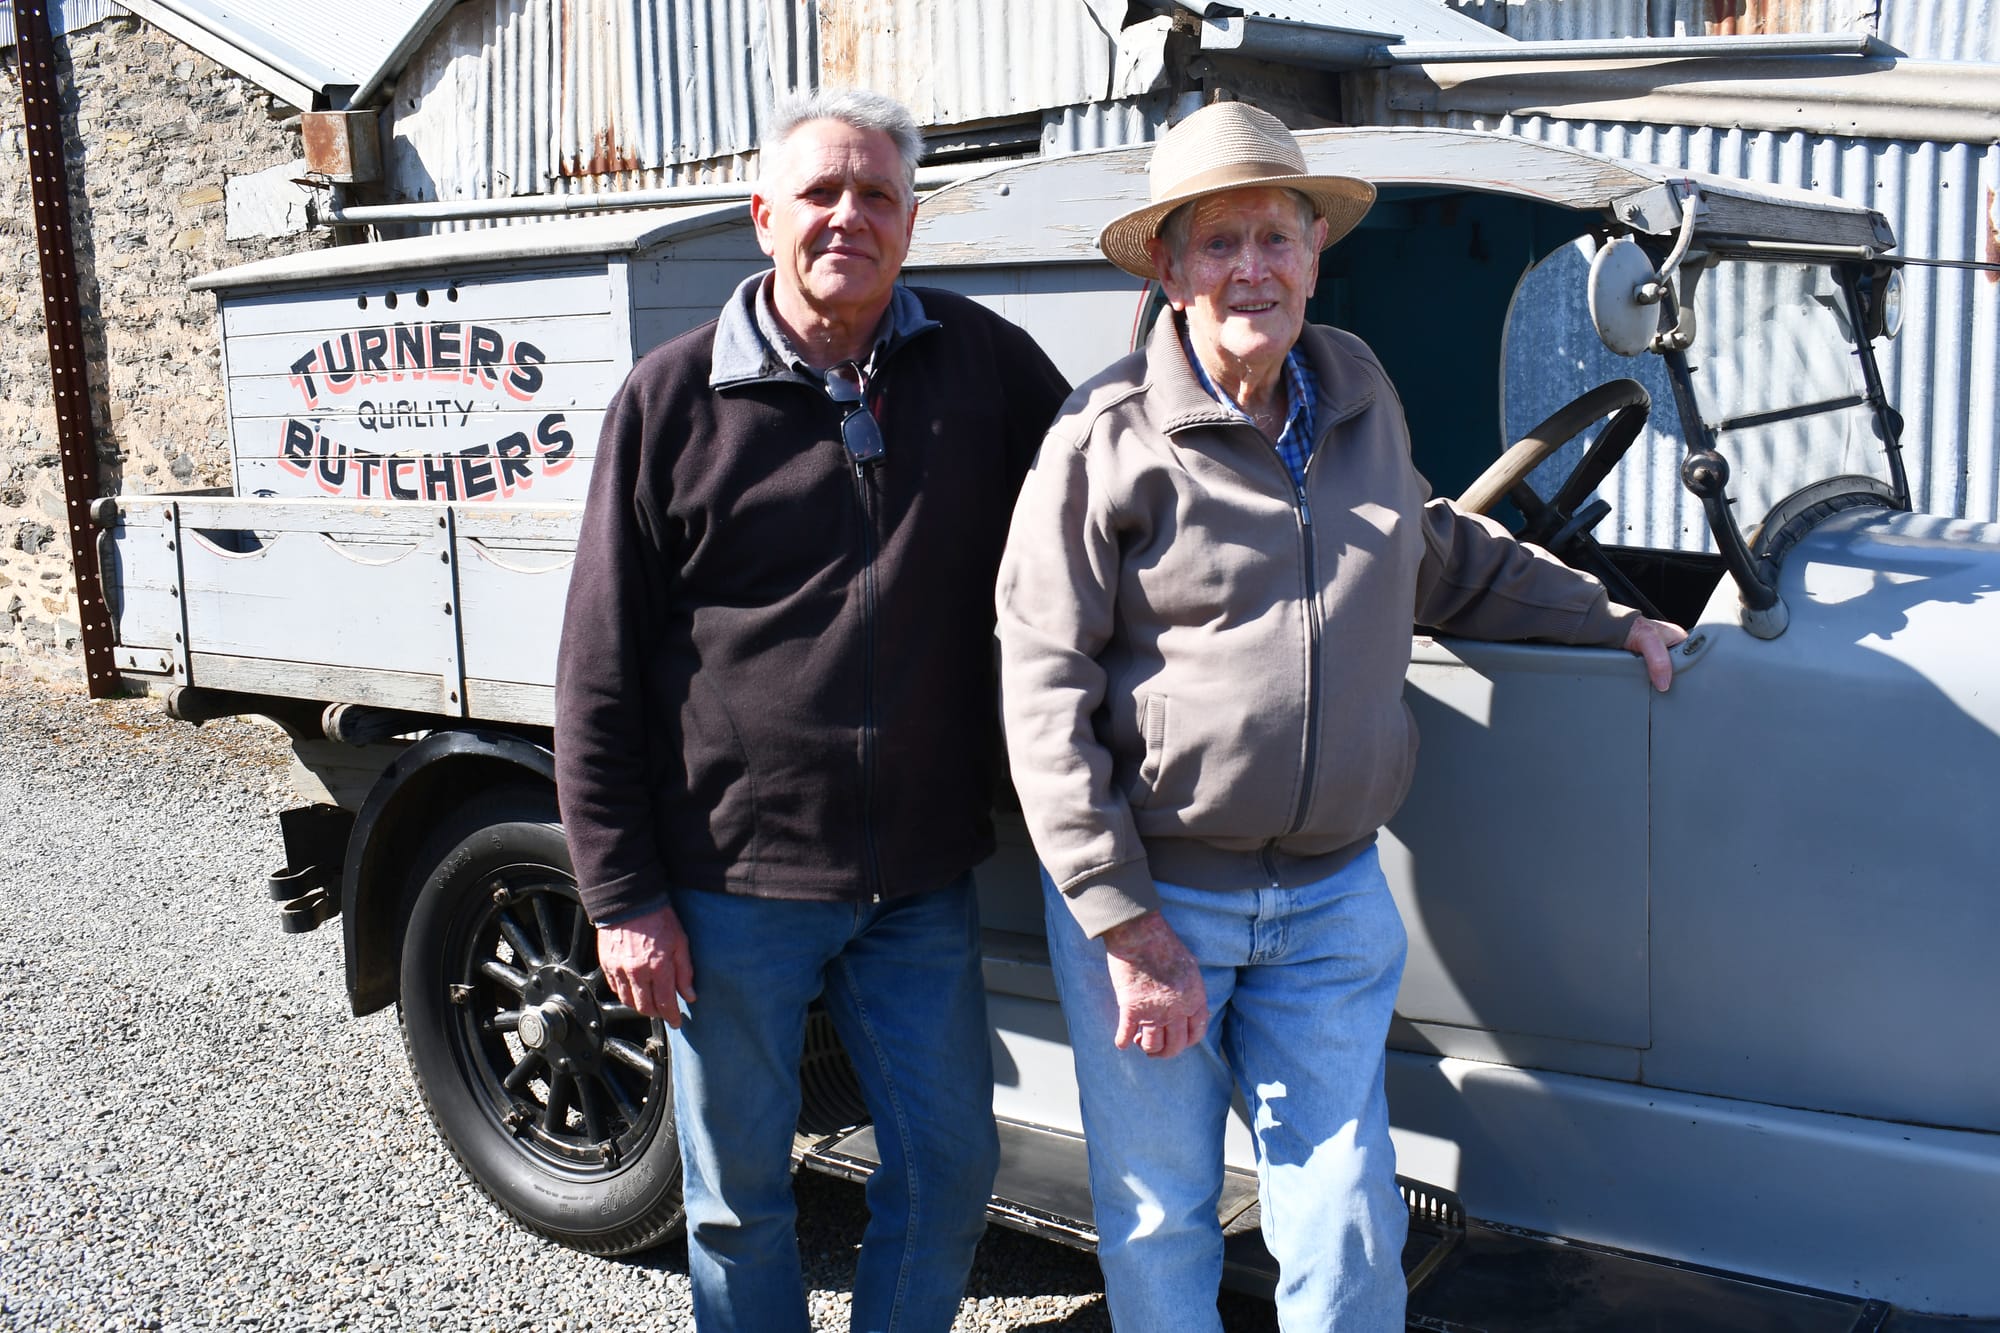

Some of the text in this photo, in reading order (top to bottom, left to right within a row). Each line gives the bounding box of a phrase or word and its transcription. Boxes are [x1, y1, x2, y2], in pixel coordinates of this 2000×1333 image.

[290, 321, 546, 407] TURNERS
[279, 413, 575, 501] BUTCHERS
[358, 399, 475, 433] QUALITY
